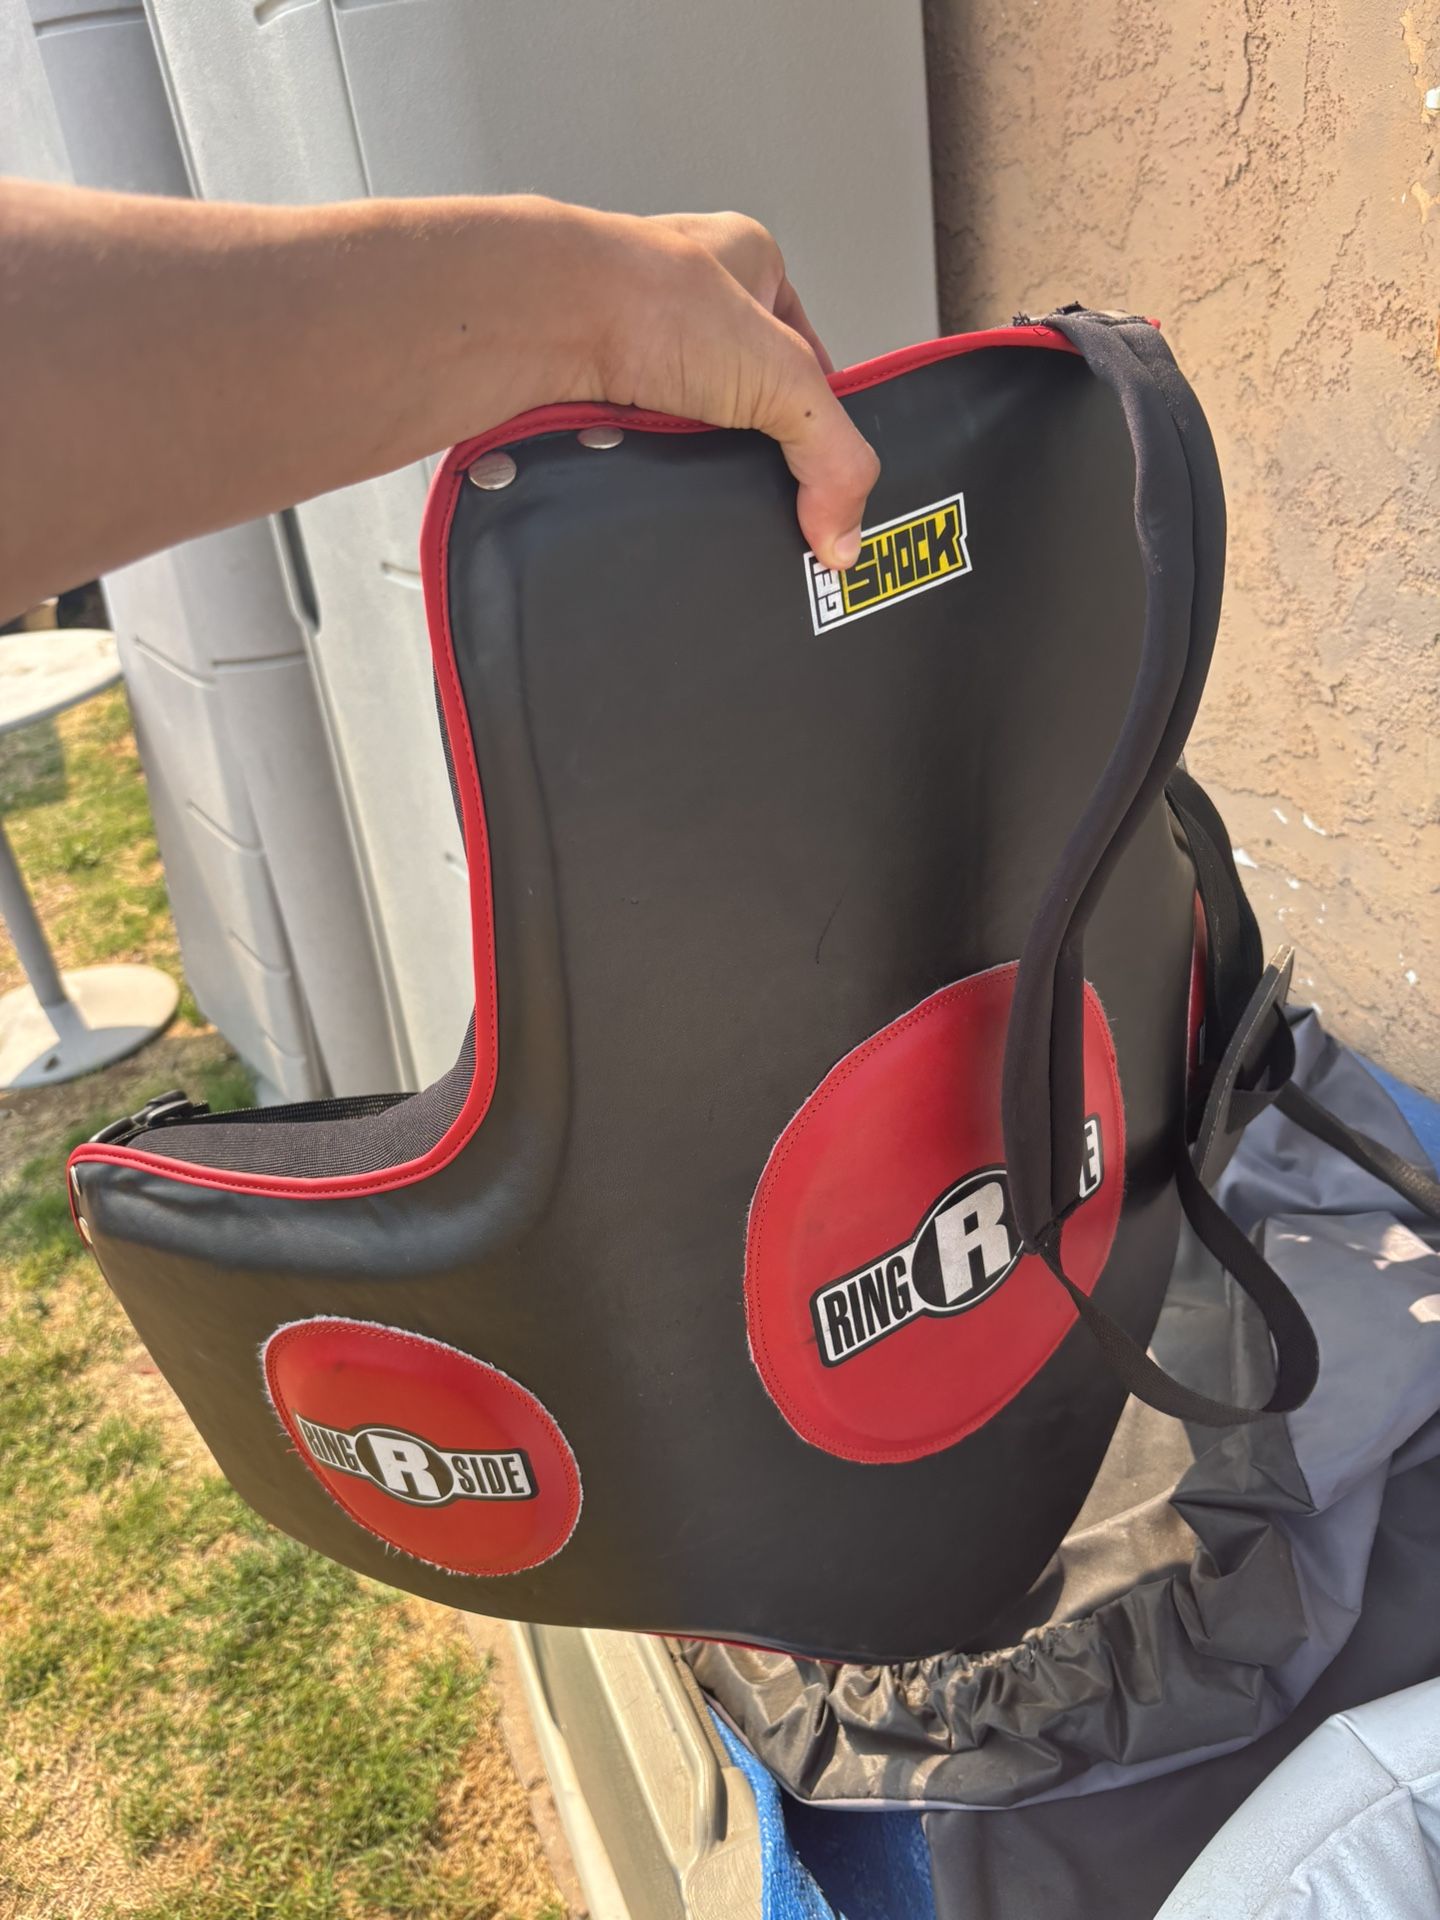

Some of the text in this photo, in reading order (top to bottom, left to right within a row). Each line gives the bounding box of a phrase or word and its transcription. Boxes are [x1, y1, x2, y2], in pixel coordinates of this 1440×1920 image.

[845, 508, 960, 609] SHOCK
[823, 1181, 1012, 1357] RING R
[300, 1419, 526, 1498] RING R SIDE
